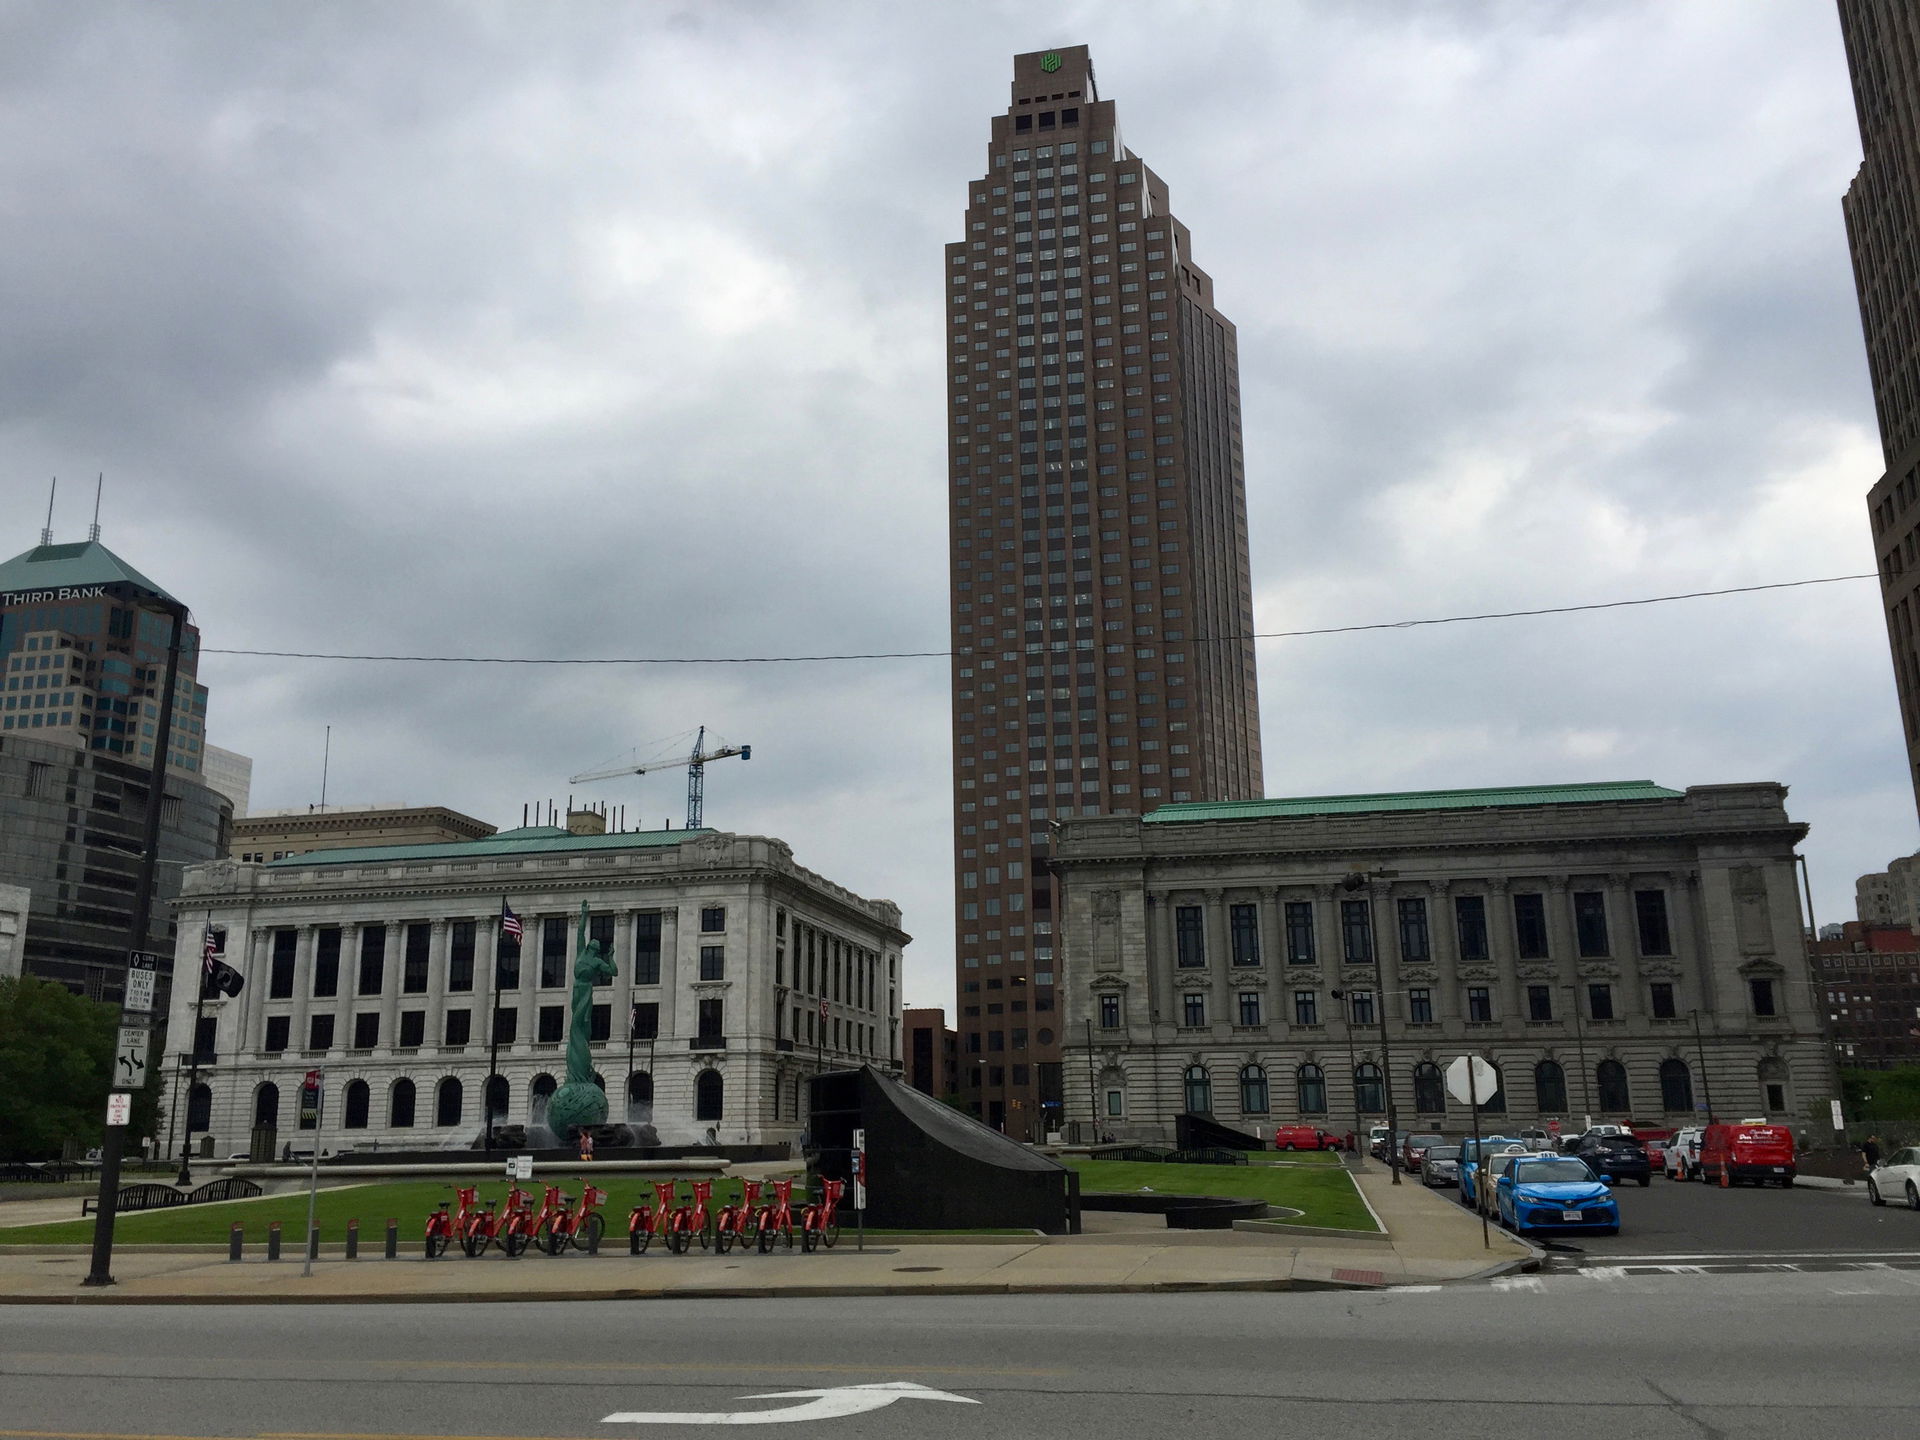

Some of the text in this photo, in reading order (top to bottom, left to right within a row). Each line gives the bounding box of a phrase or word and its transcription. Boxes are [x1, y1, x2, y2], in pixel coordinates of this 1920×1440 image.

[2, 586, 105, 607] THIRD BANK
[131, 970, 153, 981] BUSES
[133, 980, 149, 989] ONLY
